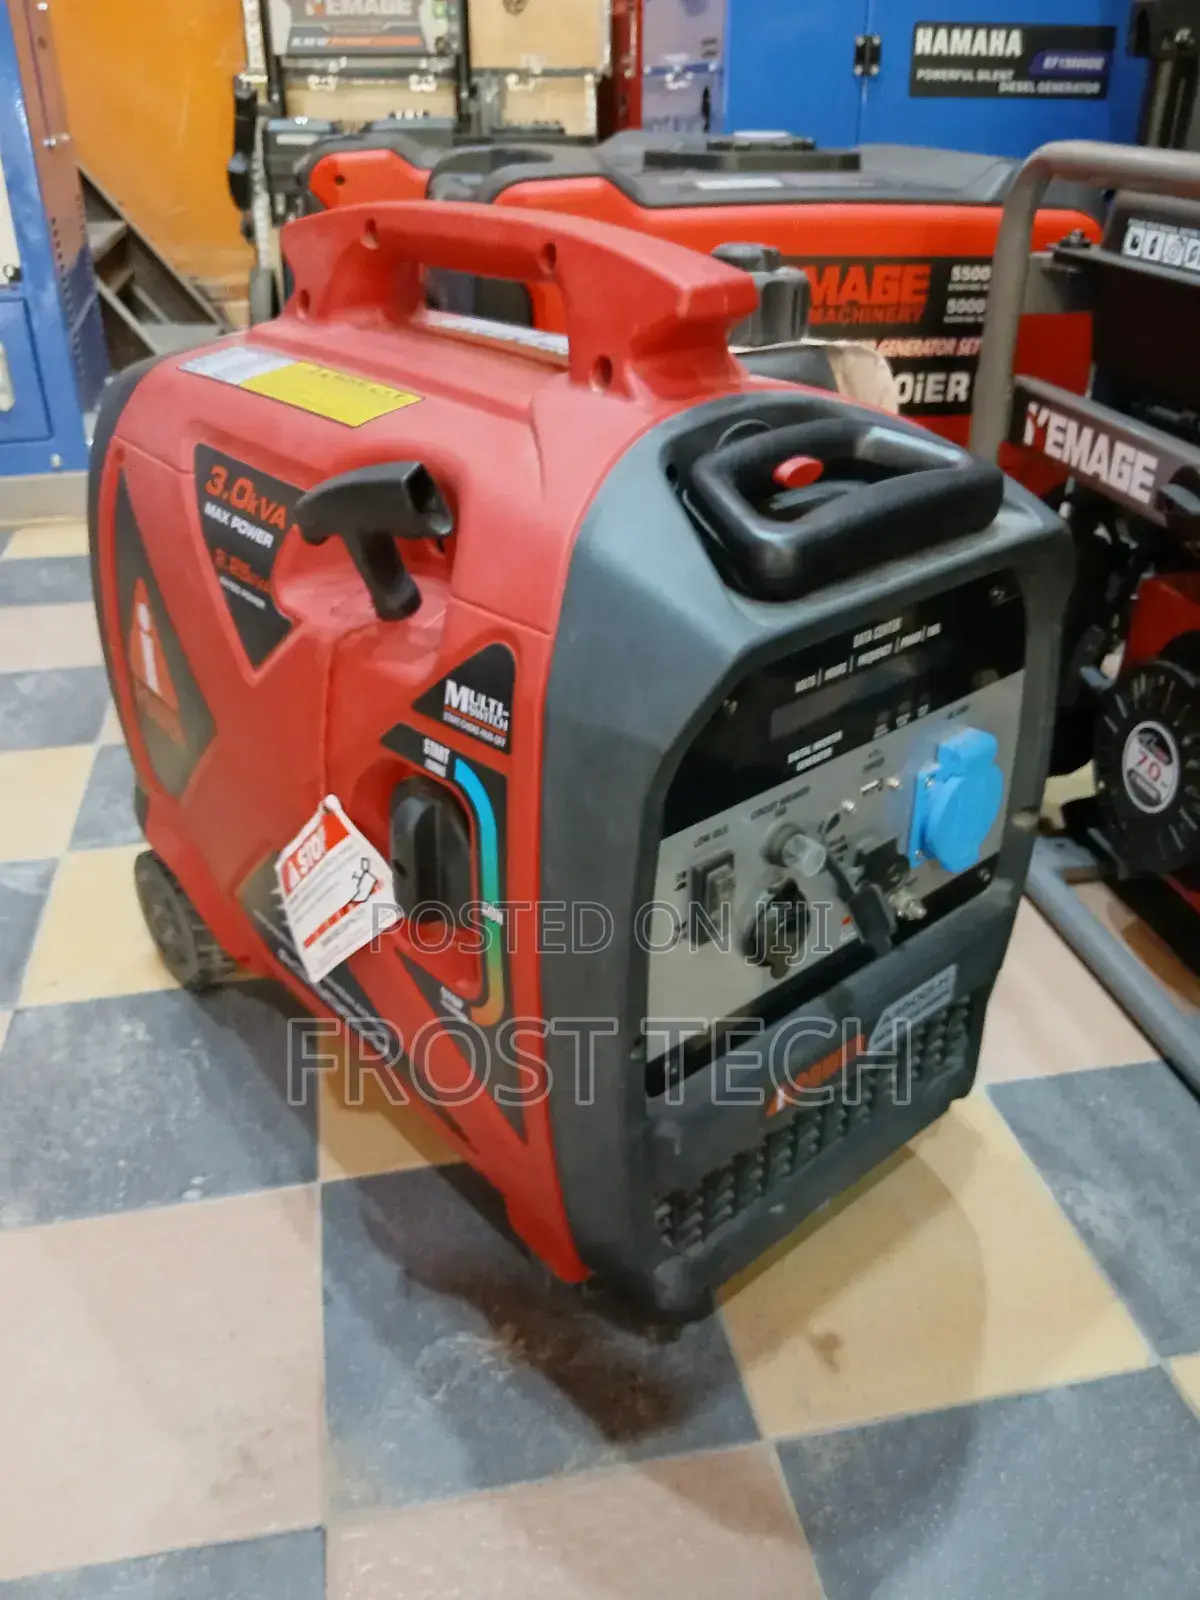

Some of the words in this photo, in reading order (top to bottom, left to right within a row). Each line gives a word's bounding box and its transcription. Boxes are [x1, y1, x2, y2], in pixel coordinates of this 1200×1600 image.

[915, 27, 1023, 58] HAMAHA
[204, 464, 287, 530] 3.0kVA
[204, 501, 232, 526] MAX
[230, 515, 274, 549] POWER
